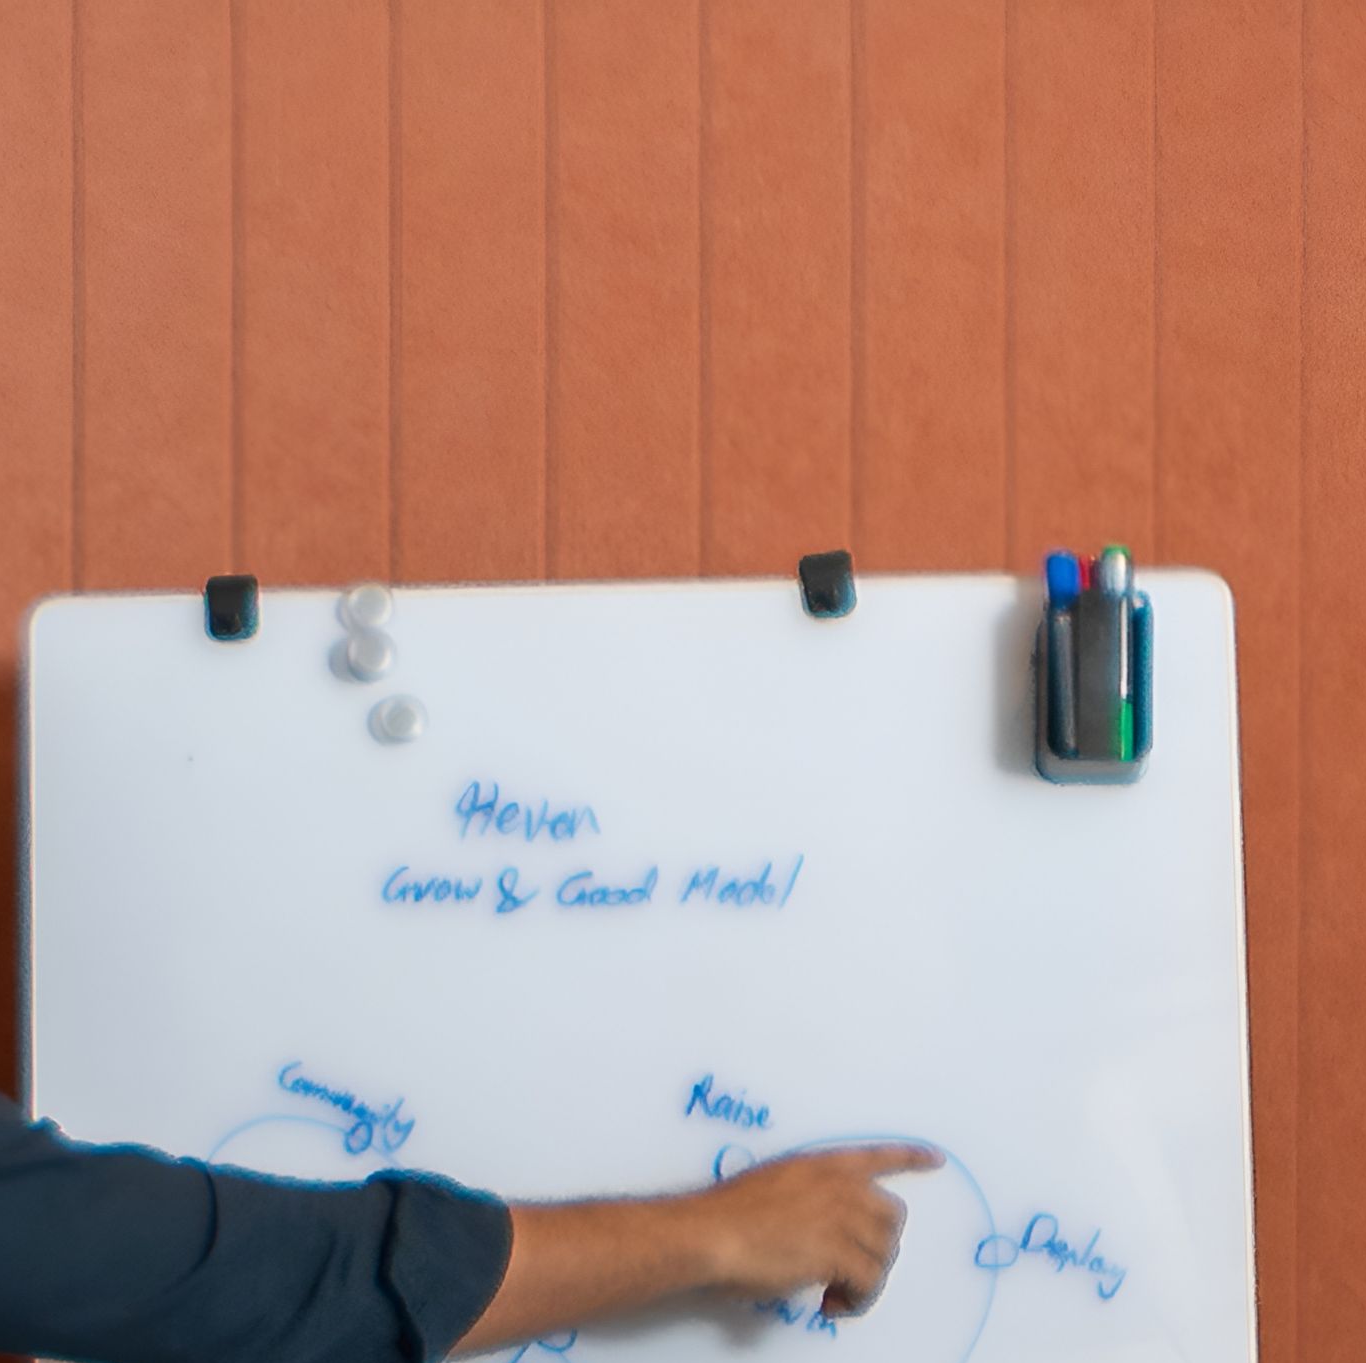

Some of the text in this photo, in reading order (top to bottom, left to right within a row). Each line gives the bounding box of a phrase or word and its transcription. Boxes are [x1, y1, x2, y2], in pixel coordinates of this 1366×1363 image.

[495, 866, 540, 914] &
[556, 864, 659, 907] Good
[685, 1073, 772, 1130] Raise
